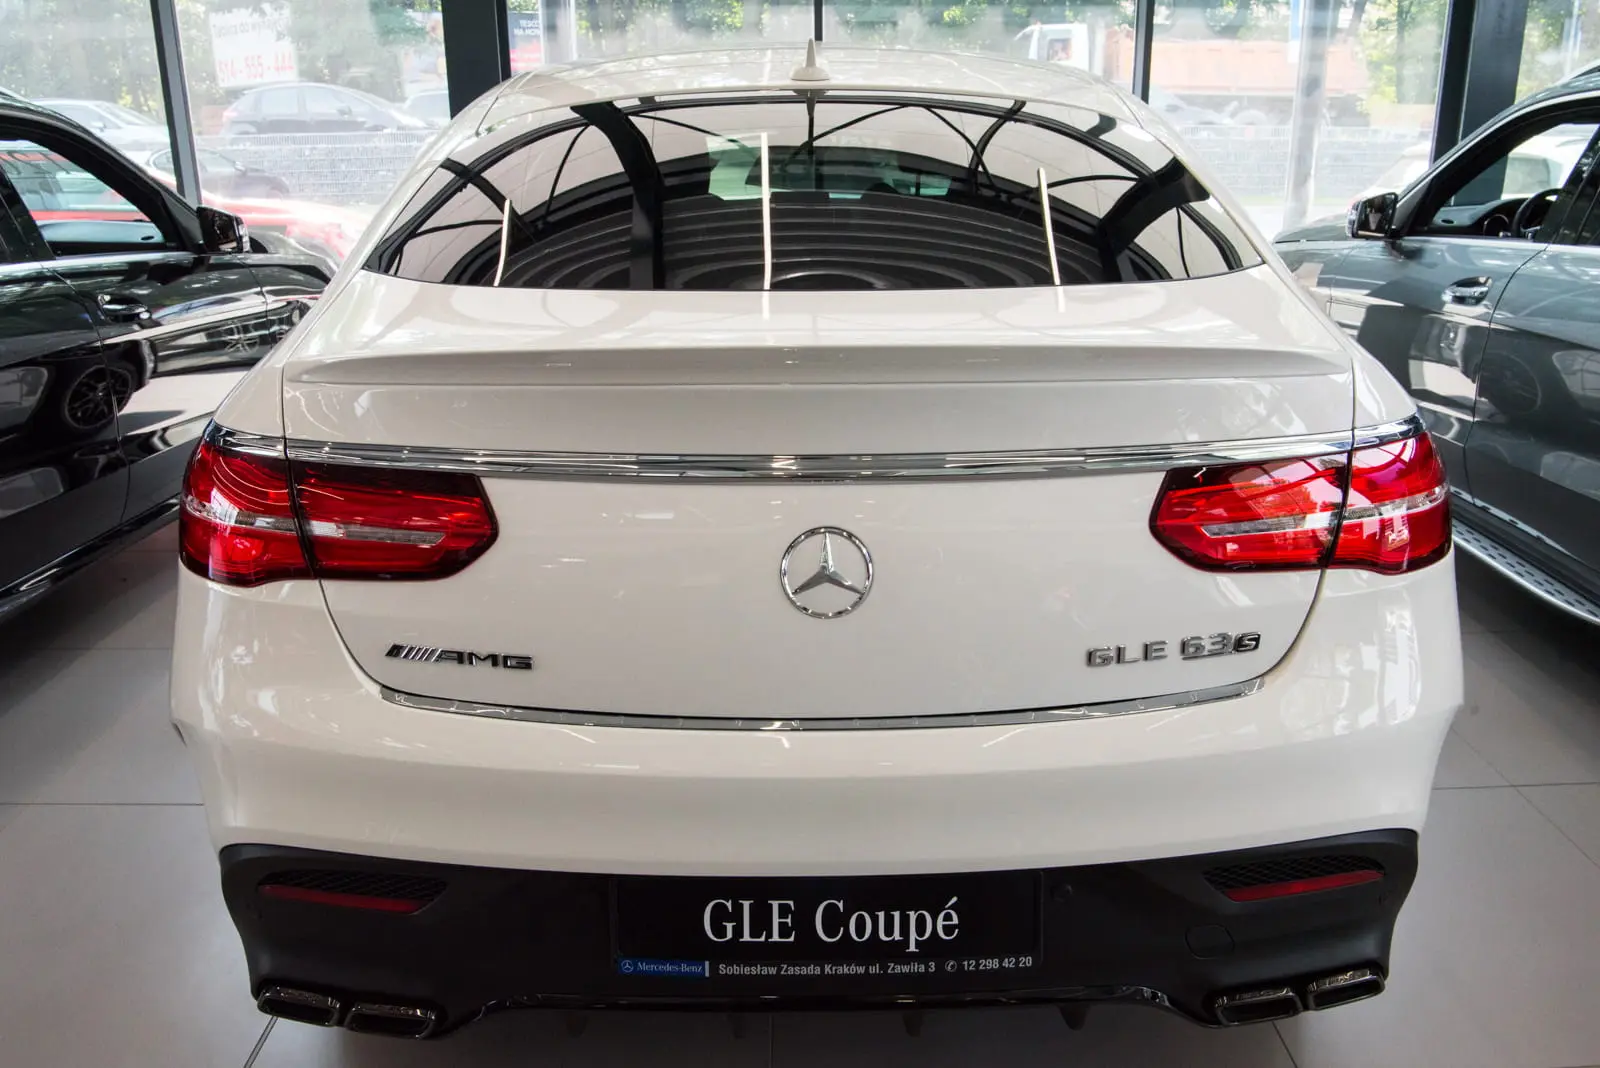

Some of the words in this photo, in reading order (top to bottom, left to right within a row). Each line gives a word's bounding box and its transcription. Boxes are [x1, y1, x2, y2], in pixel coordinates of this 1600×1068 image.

[1087, 640, 1168, 668] GLE
[703, 899, 796, 942] GLE
[814, 896, 959, 952] Coupé
[636, 960, 704, 974] Mercedes-Benz
[718, 963, 778, 975] Sobiesław
[780, 964, 822, 975] Zasada
[824, 963, 866, 975] Kraków
[868, 963, 884, 974] ul.
[887, 962, 926, 974] Zawiła
[928, 961, 936, 973] 3
[962, 959, 976, 971] 12
[979, 958, 1000, 970] 298
[1002, 957, 1016, 968] 42
[1018, 956, 1033, 967] 20
